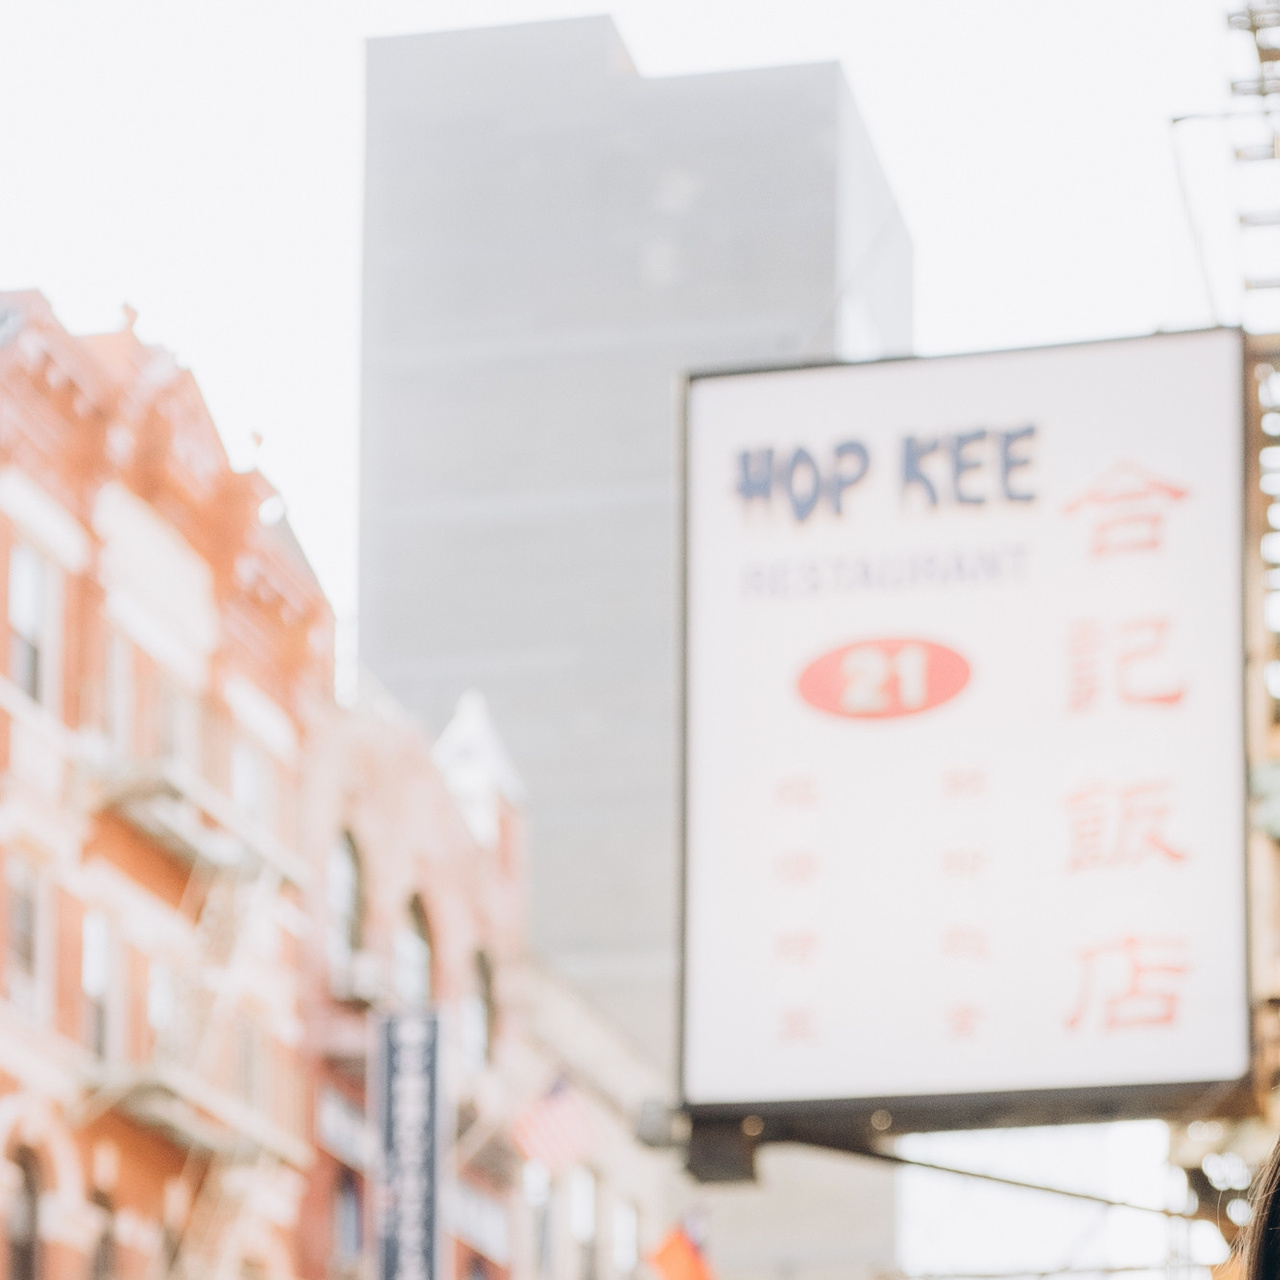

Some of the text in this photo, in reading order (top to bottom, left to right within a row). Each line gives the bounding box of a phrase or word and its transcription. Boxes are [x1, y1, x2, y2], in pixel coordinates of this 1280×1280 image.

[737, 426, 1037, 522] HOP KEE
[741, 545, 1028, 597] RESTAURANT
[838, 644, 929, 712] 21
[1062, 460, 1190, 1034] 合記飯店
